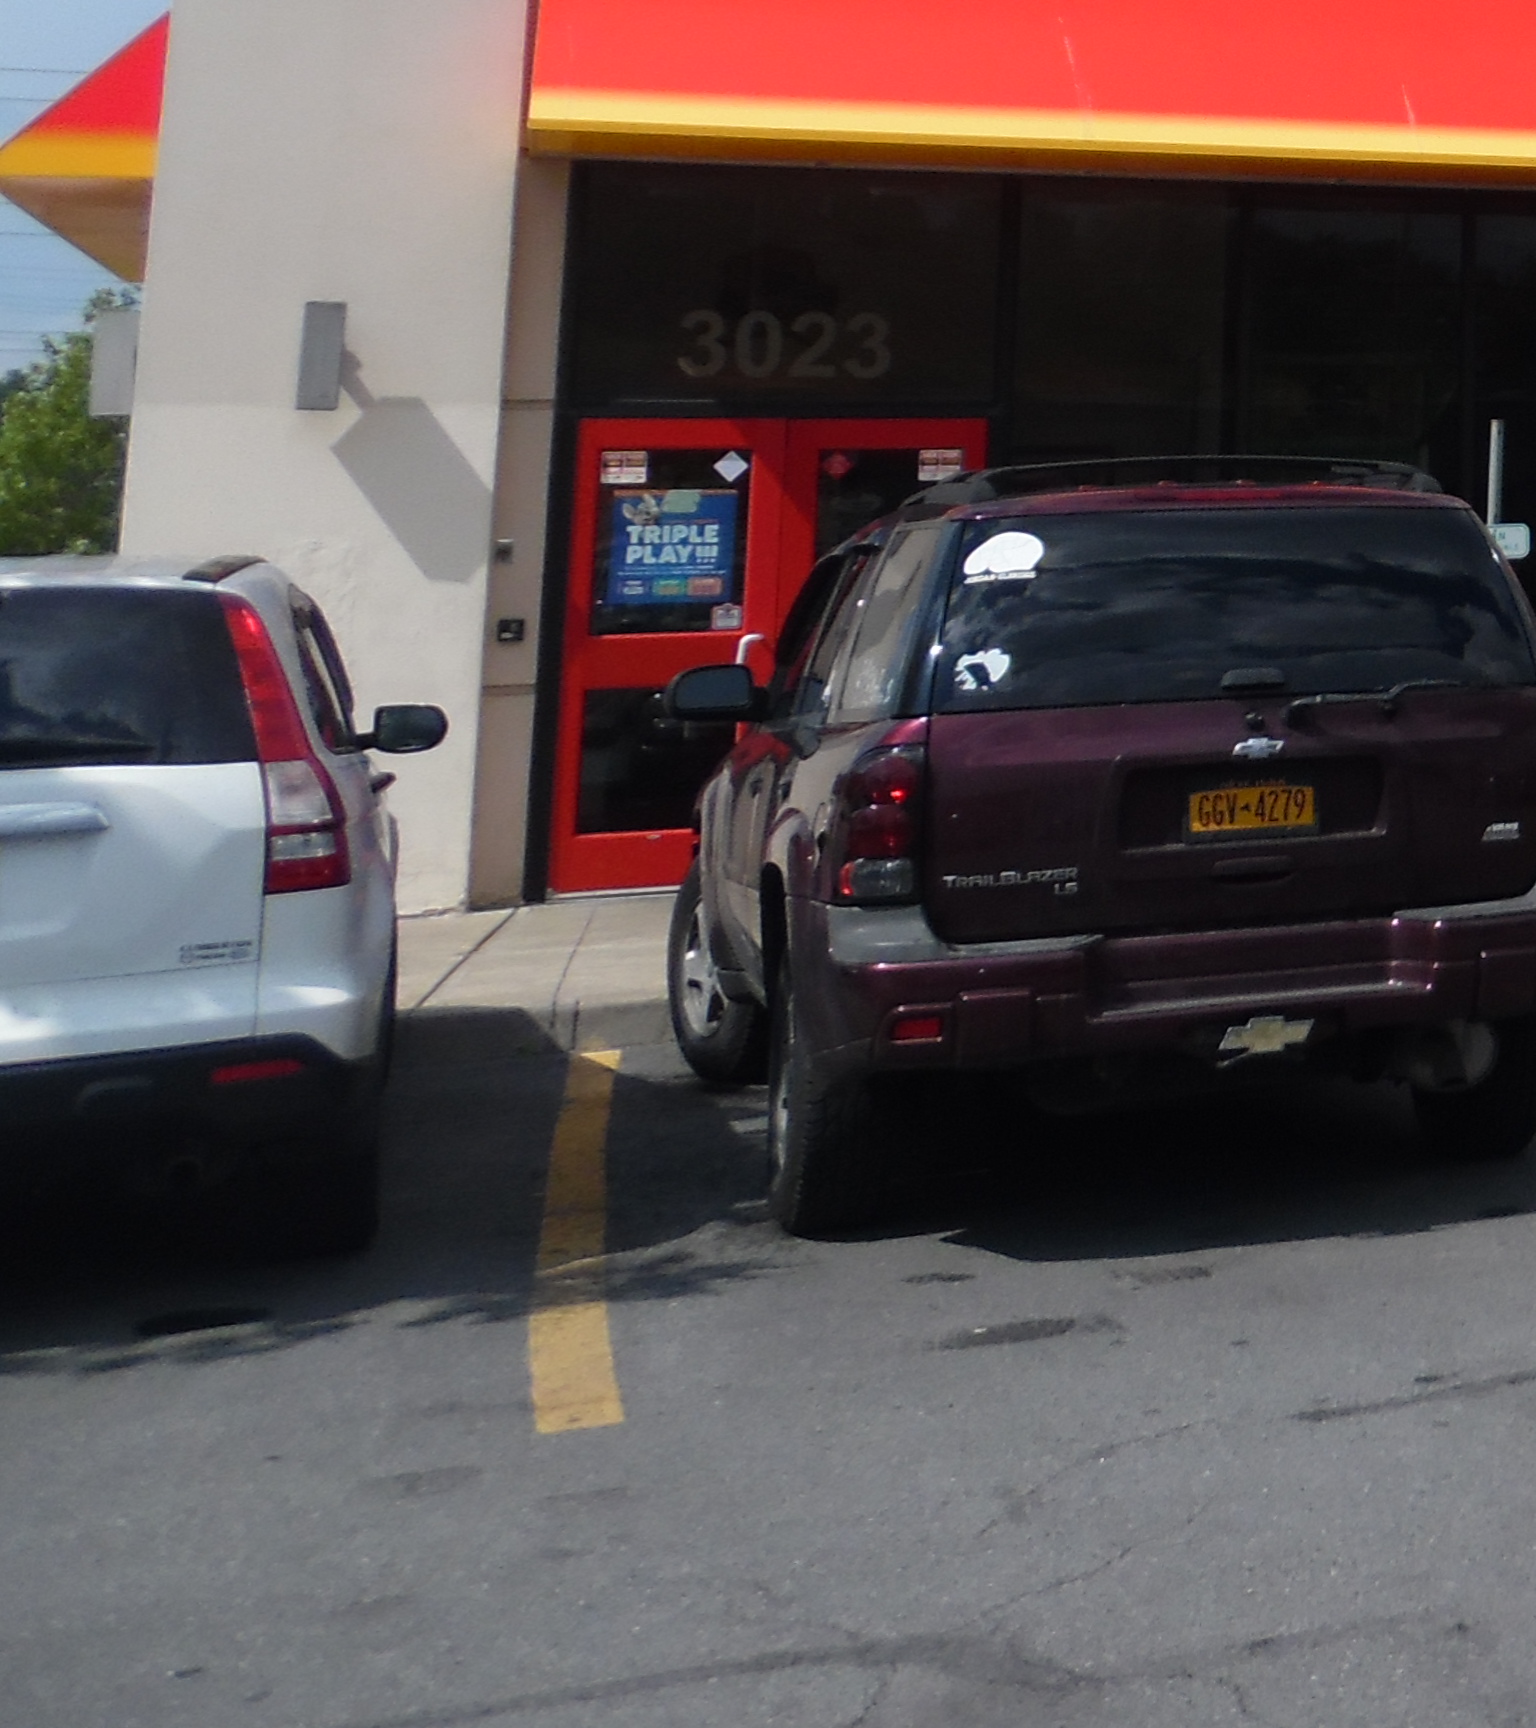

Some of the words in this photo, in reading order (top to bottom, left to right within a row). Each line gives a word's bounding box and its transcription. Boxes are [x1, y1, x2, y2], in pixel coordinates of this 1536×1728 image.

[677, 309, 891, 379] 3023
[625, 524, 720, 544] TRIPLE
[625, 544, 719, 565] PLAY!!!
